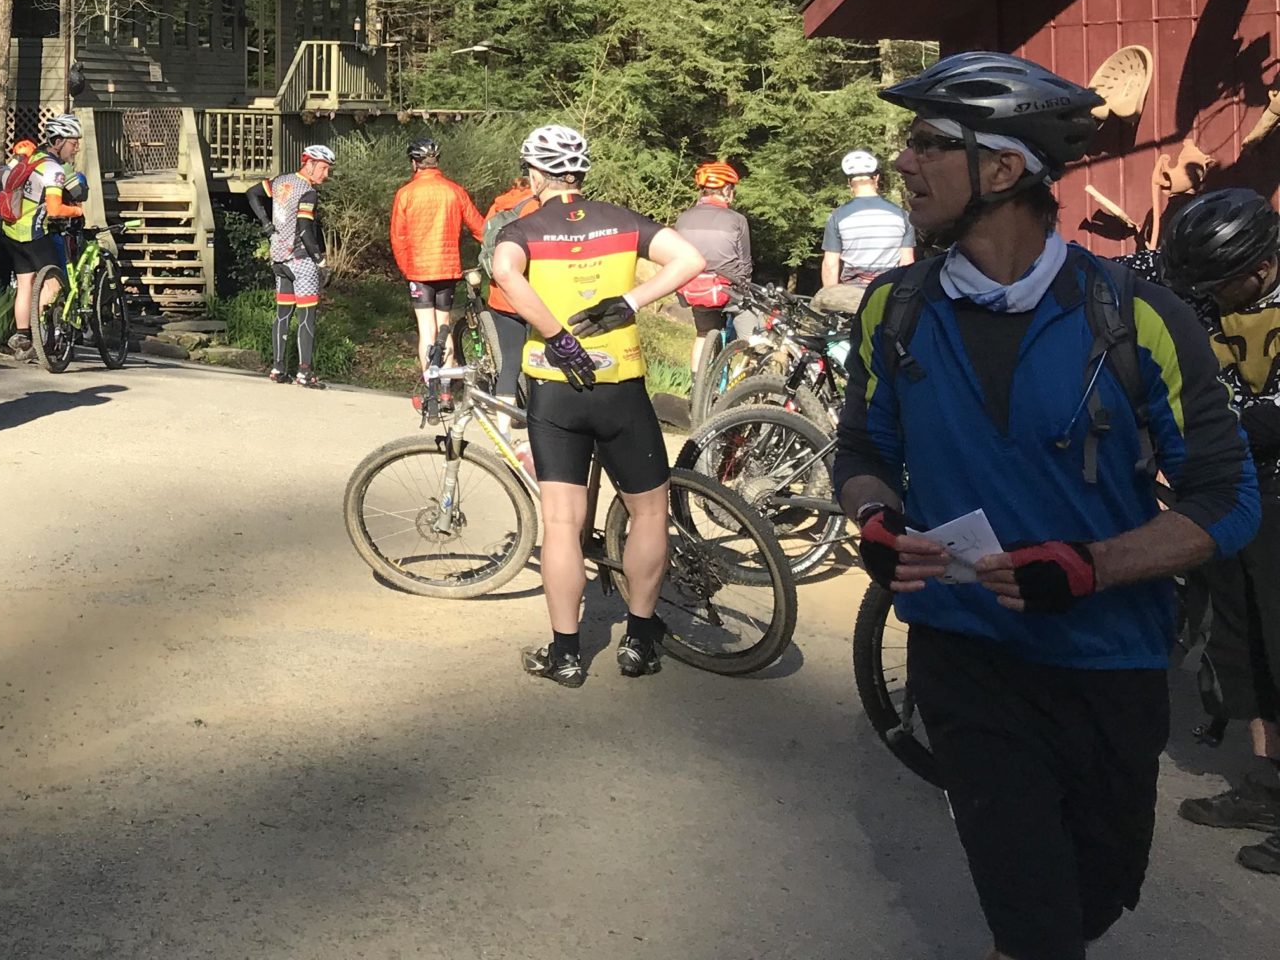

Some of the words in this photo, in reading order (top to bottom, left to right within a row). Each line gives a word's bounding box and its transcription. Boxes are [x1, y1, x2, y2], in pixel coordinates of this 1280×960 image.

[543, 234, 586, 242] REALITY
[588, 228, 618, 240] BIKES
[568, 260, 602, 269] FUJI
